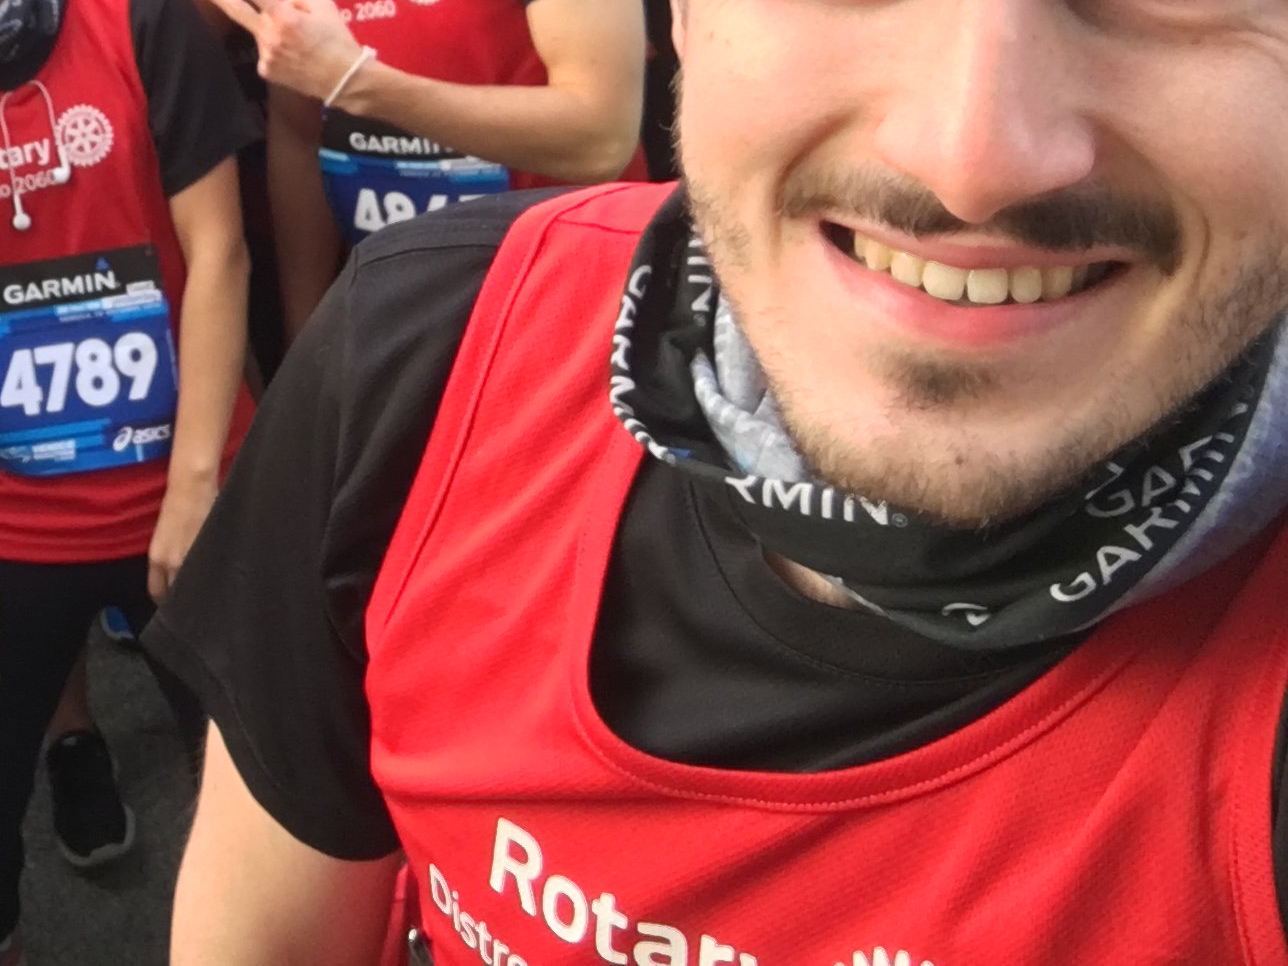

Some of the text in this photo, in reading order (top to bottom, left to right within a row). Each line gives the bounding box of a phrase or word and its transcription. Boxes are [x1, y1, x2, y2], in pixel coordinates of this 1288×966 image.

[353, 0, 397, 22] 2060
[349, 132, 453, 154] GARMI
[3, 271, 117, 305] GARMIN
[0, 331, 158, 416] 4789
[489, 817, 758, 966] Rotar
